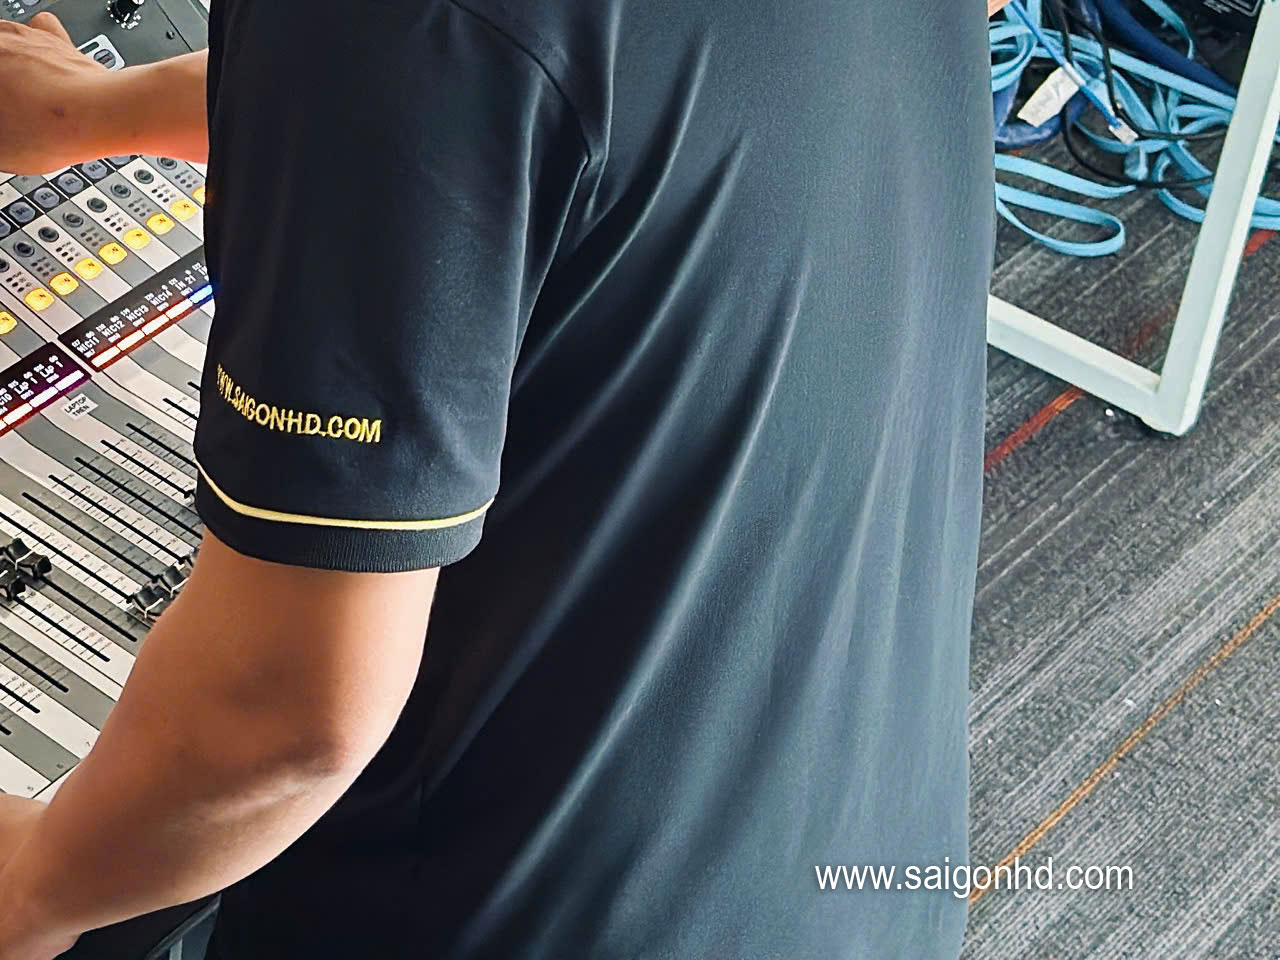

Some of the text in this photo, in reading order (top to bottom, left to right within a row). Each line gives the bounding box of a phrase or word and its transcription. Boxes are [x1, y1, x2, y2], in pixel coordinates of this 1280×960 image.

[174, 274, 196, 290] IN 21
[149, 289, 174, 306] MIC14
[124, 304, 150, 322] MIC13
[100, 320, 125, 337] MIC12
[75, 336, 101, 354] MIC11
[39, 364, 56, 378] LAP
[13, 381, 31, 394] LAP
